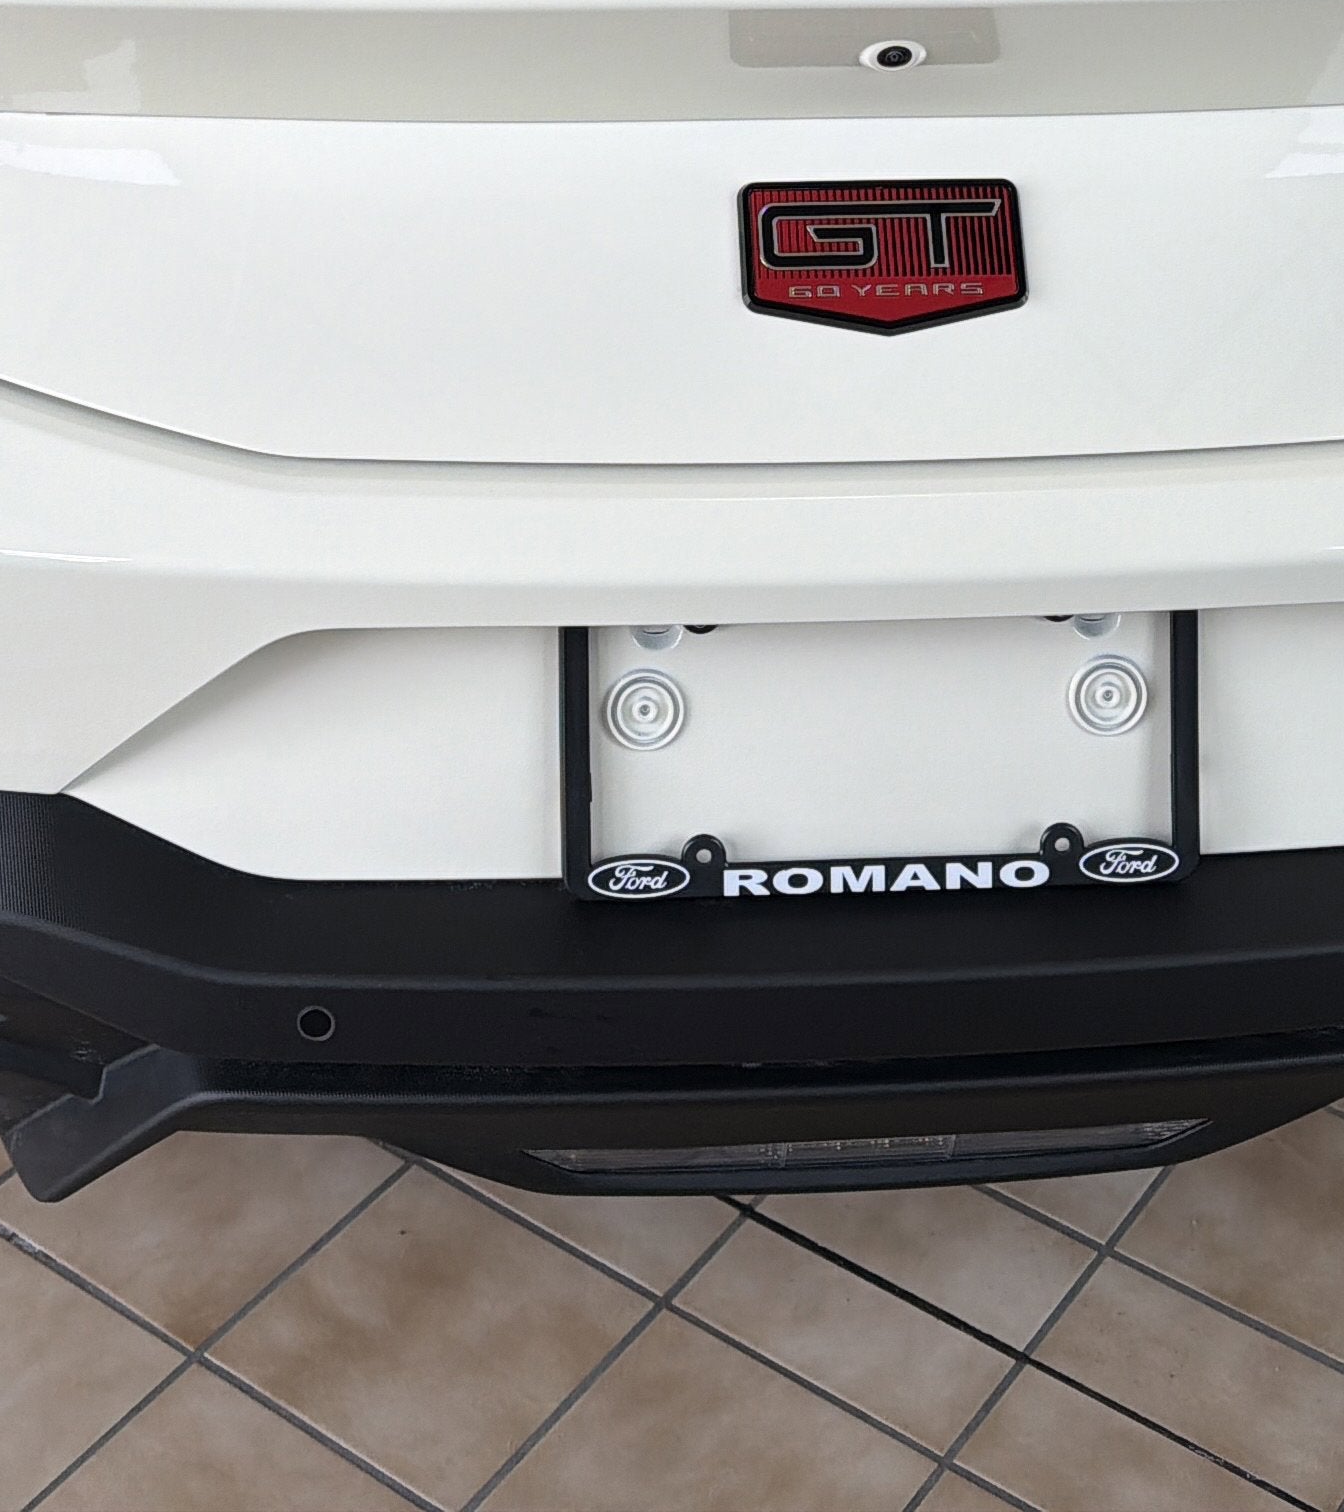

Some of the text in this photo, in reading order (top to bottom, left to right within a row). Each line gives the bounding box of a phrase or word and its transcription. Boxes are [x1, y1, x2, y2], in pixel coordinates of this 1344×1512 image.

[757, 197, 1003, 272] GT
[788, 281, 984, 299] 60 YEARS
[1099, 848, 1158, 875] Ford
[609, 864, 669, 891] Ford
[722, 859, 1052, 898] ROMANO
